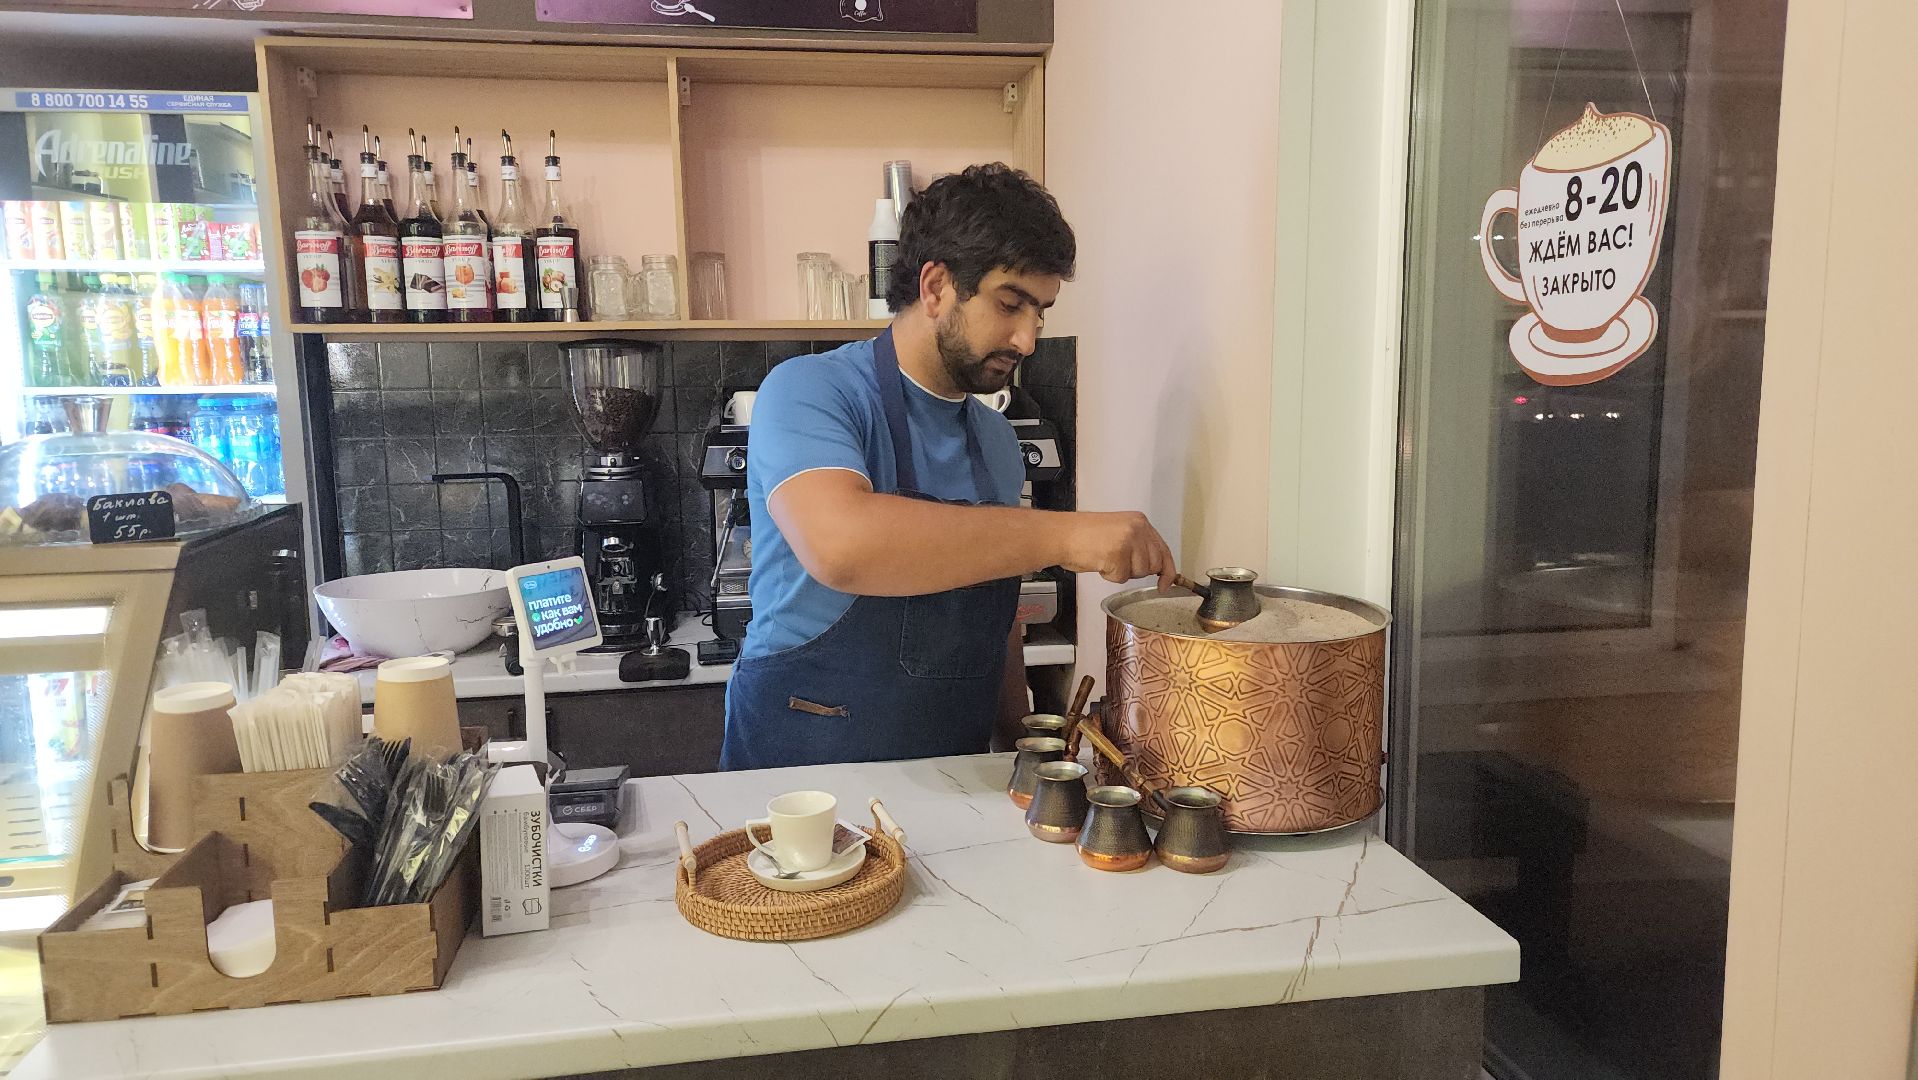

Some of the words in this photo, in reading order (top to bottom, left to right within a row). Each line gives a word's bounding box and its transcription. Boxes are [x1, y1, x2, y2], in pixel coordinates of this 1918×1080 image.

[31, 93, 40, 107] 8
[44, 93, 73, 107] 800
[76, 94, 105, 108] 700
[108, 95, 126, 108] 14
[128, 95, 149, 109] 55
[35, 129, 193, 178] Adrenaline
[1565, 160, 1643, 222] 8-20
[1529, 230, 1581, 264] ЖДЁМ
[1587, 223, 1633, 255] ВАС!
[1542, 268, 1617, 297] ЗАКРЫТО
[93, 492, 169, 511] Баклава
[103, 511, 111, 522] 1
[528, 594, 573, 611] платите
[541, 609, 561, 621] как
[562, 603, 583, 616] вам
[534, 616, 574, 637] удобно
[575, 805, 598, 813] СБЕР
[530, 810, 543, 888] ЗУБОЧИСТКИ
